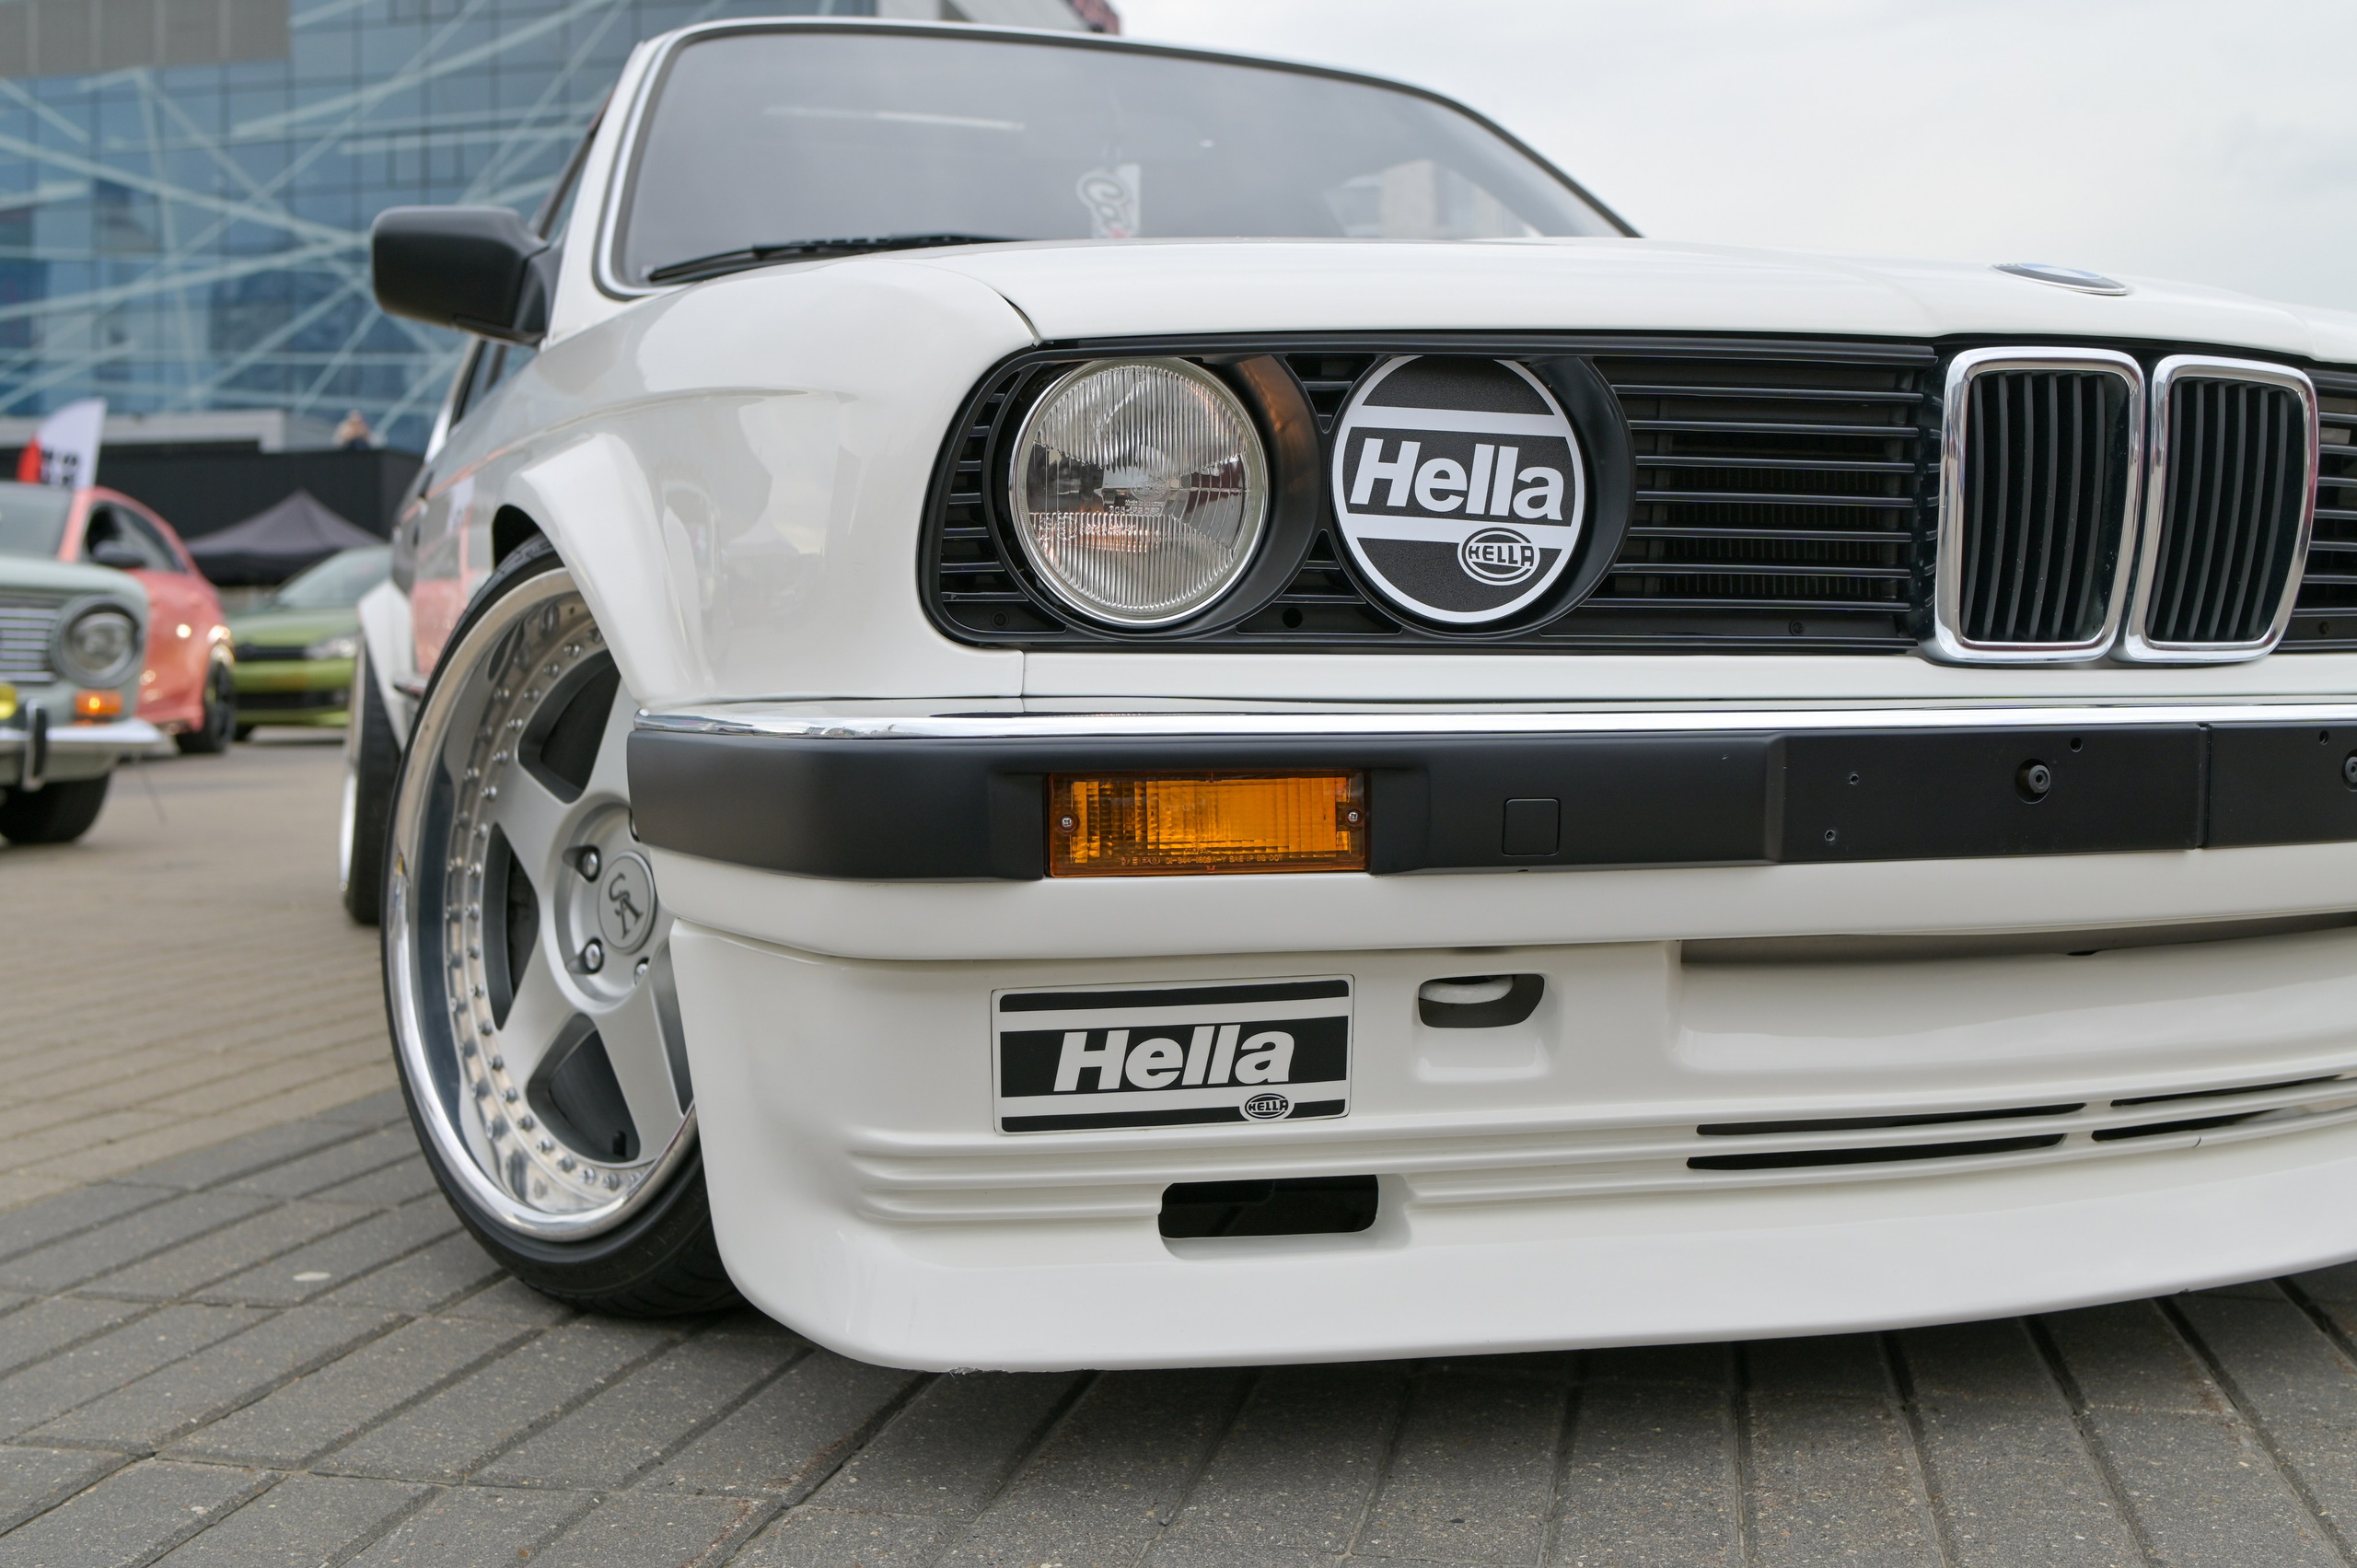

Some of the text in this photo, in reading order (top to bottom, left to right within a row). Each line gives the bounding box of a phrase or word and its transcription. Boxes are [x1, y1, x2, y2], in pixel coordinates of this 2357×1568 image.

[1350, 437, 1564, 521] Hella
[1468, 545, 1535, 567] HELLA
[1053, 1024, 1295, 1092] Hella
[1248, 1099, 1289, 1111] HELLA
